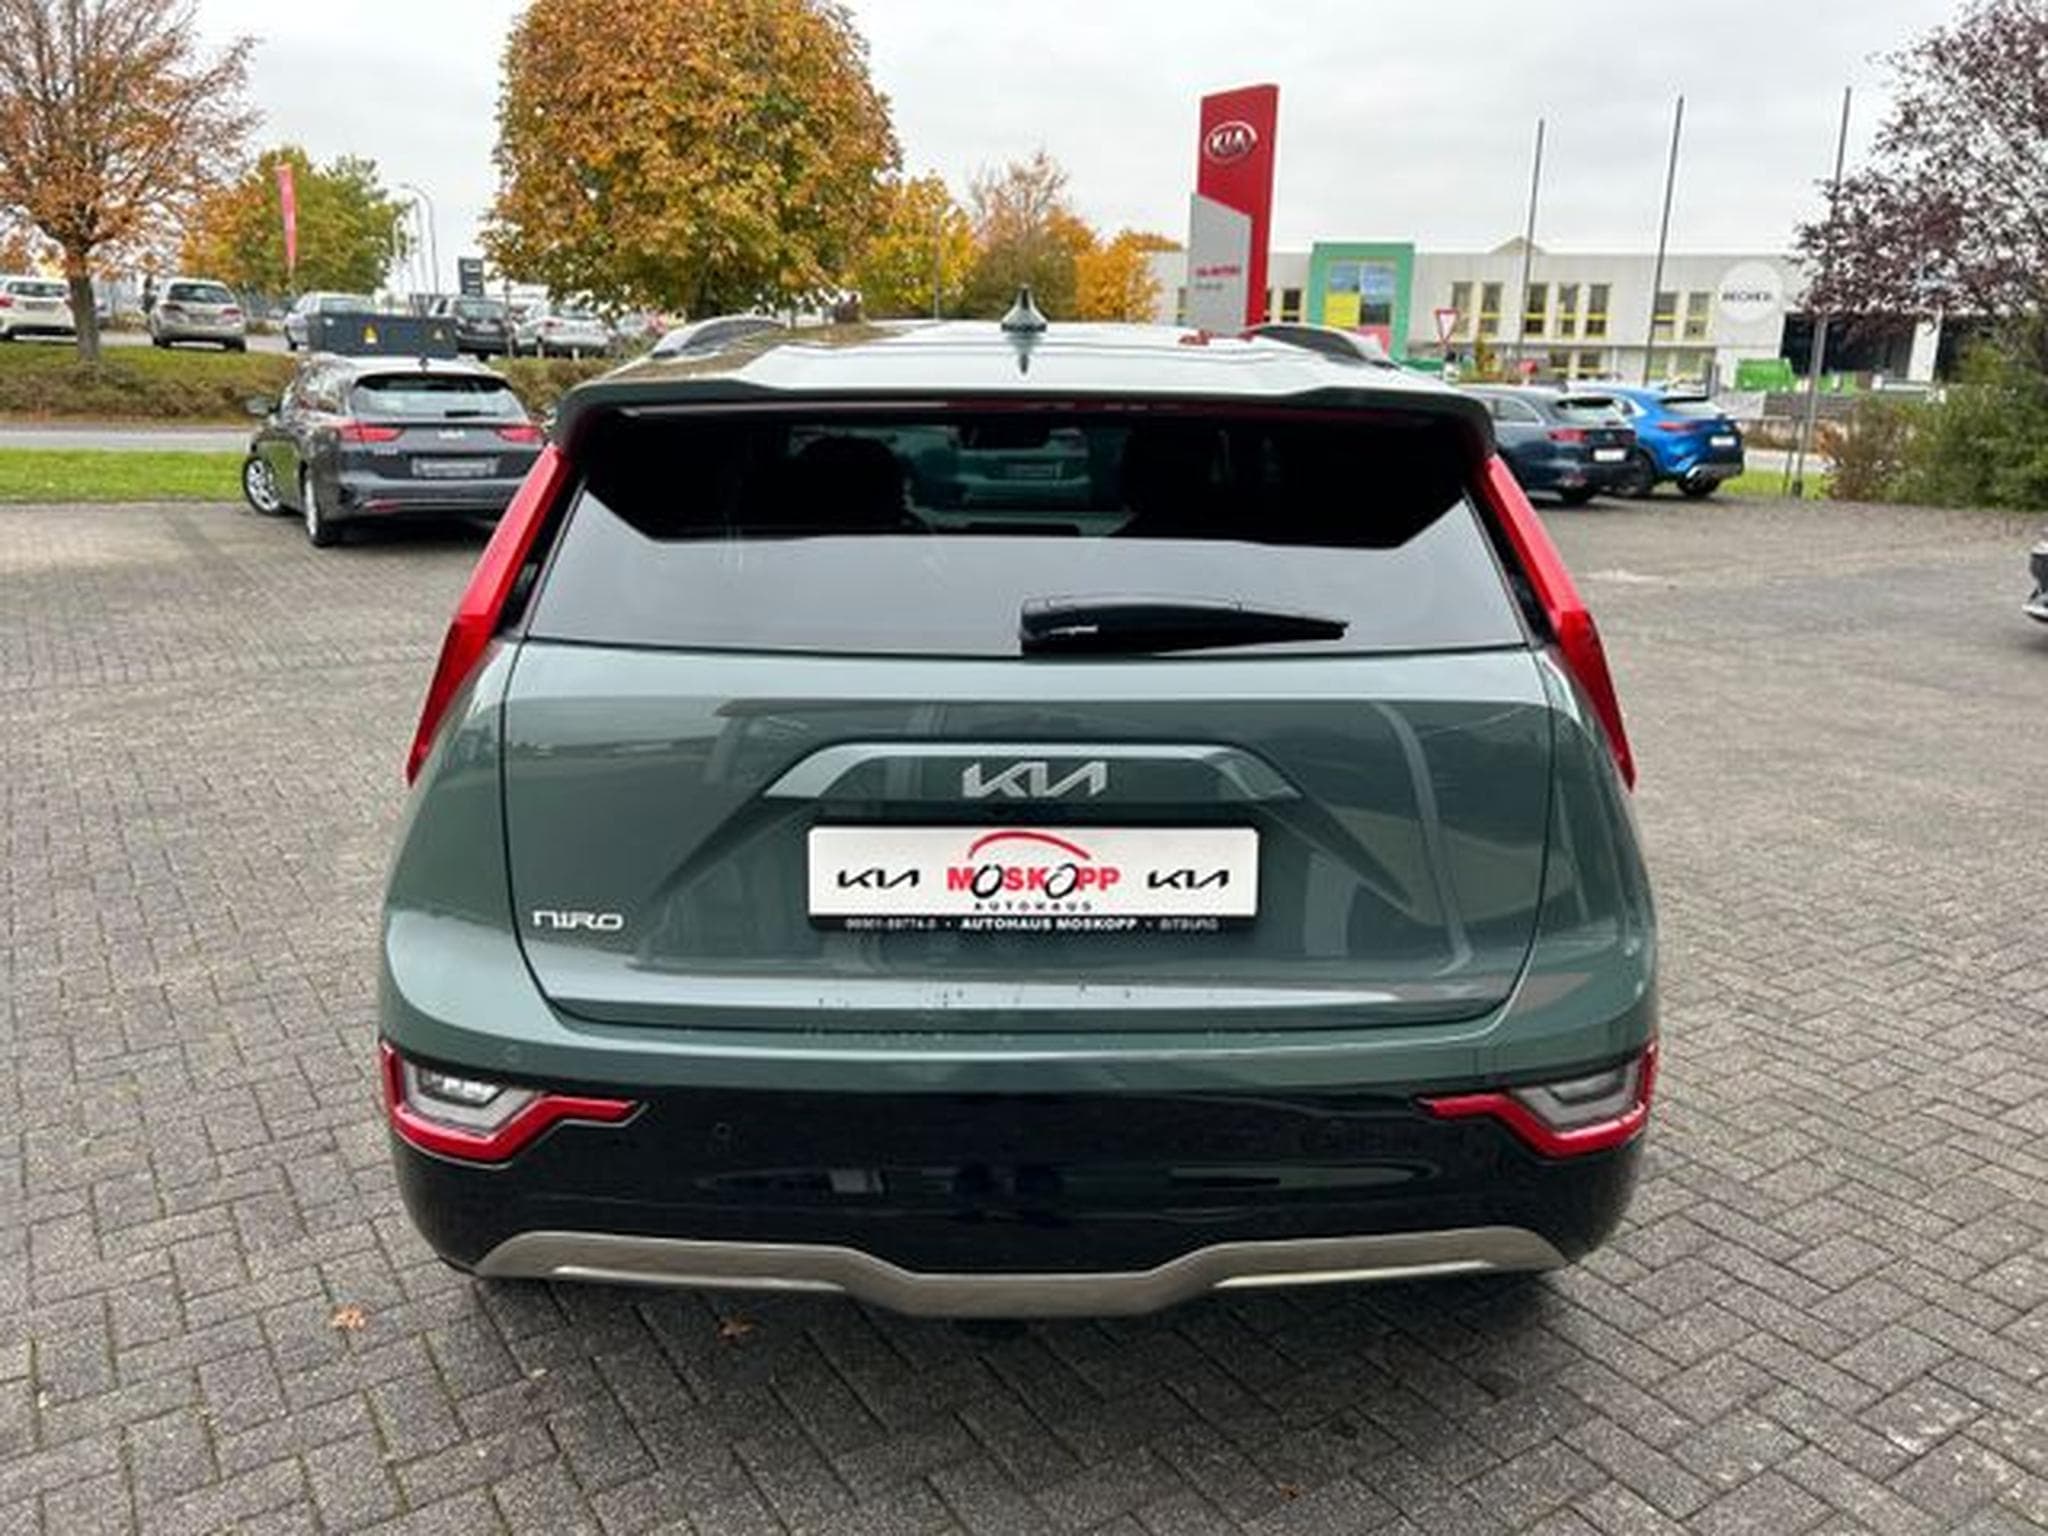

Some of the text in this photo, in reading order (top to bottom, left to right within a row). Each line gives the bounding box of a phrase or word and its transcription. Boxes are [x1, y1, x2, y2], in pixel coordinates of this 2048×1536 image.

[1211, 129, 1248, 153] KIA
[962, 760, 1108, 799] KIA
[836, 868, 920, 890] KIA
[946, 863, 1121, 899] MOSKOPP
[1146, 868, 1230, 890] KIA
[974, 901, 1093, 912] AUTOHAUS
[960, 917, 1051, 930] AUTOHAUS
[1055, 917, 1137, 930] MOSKOPP
